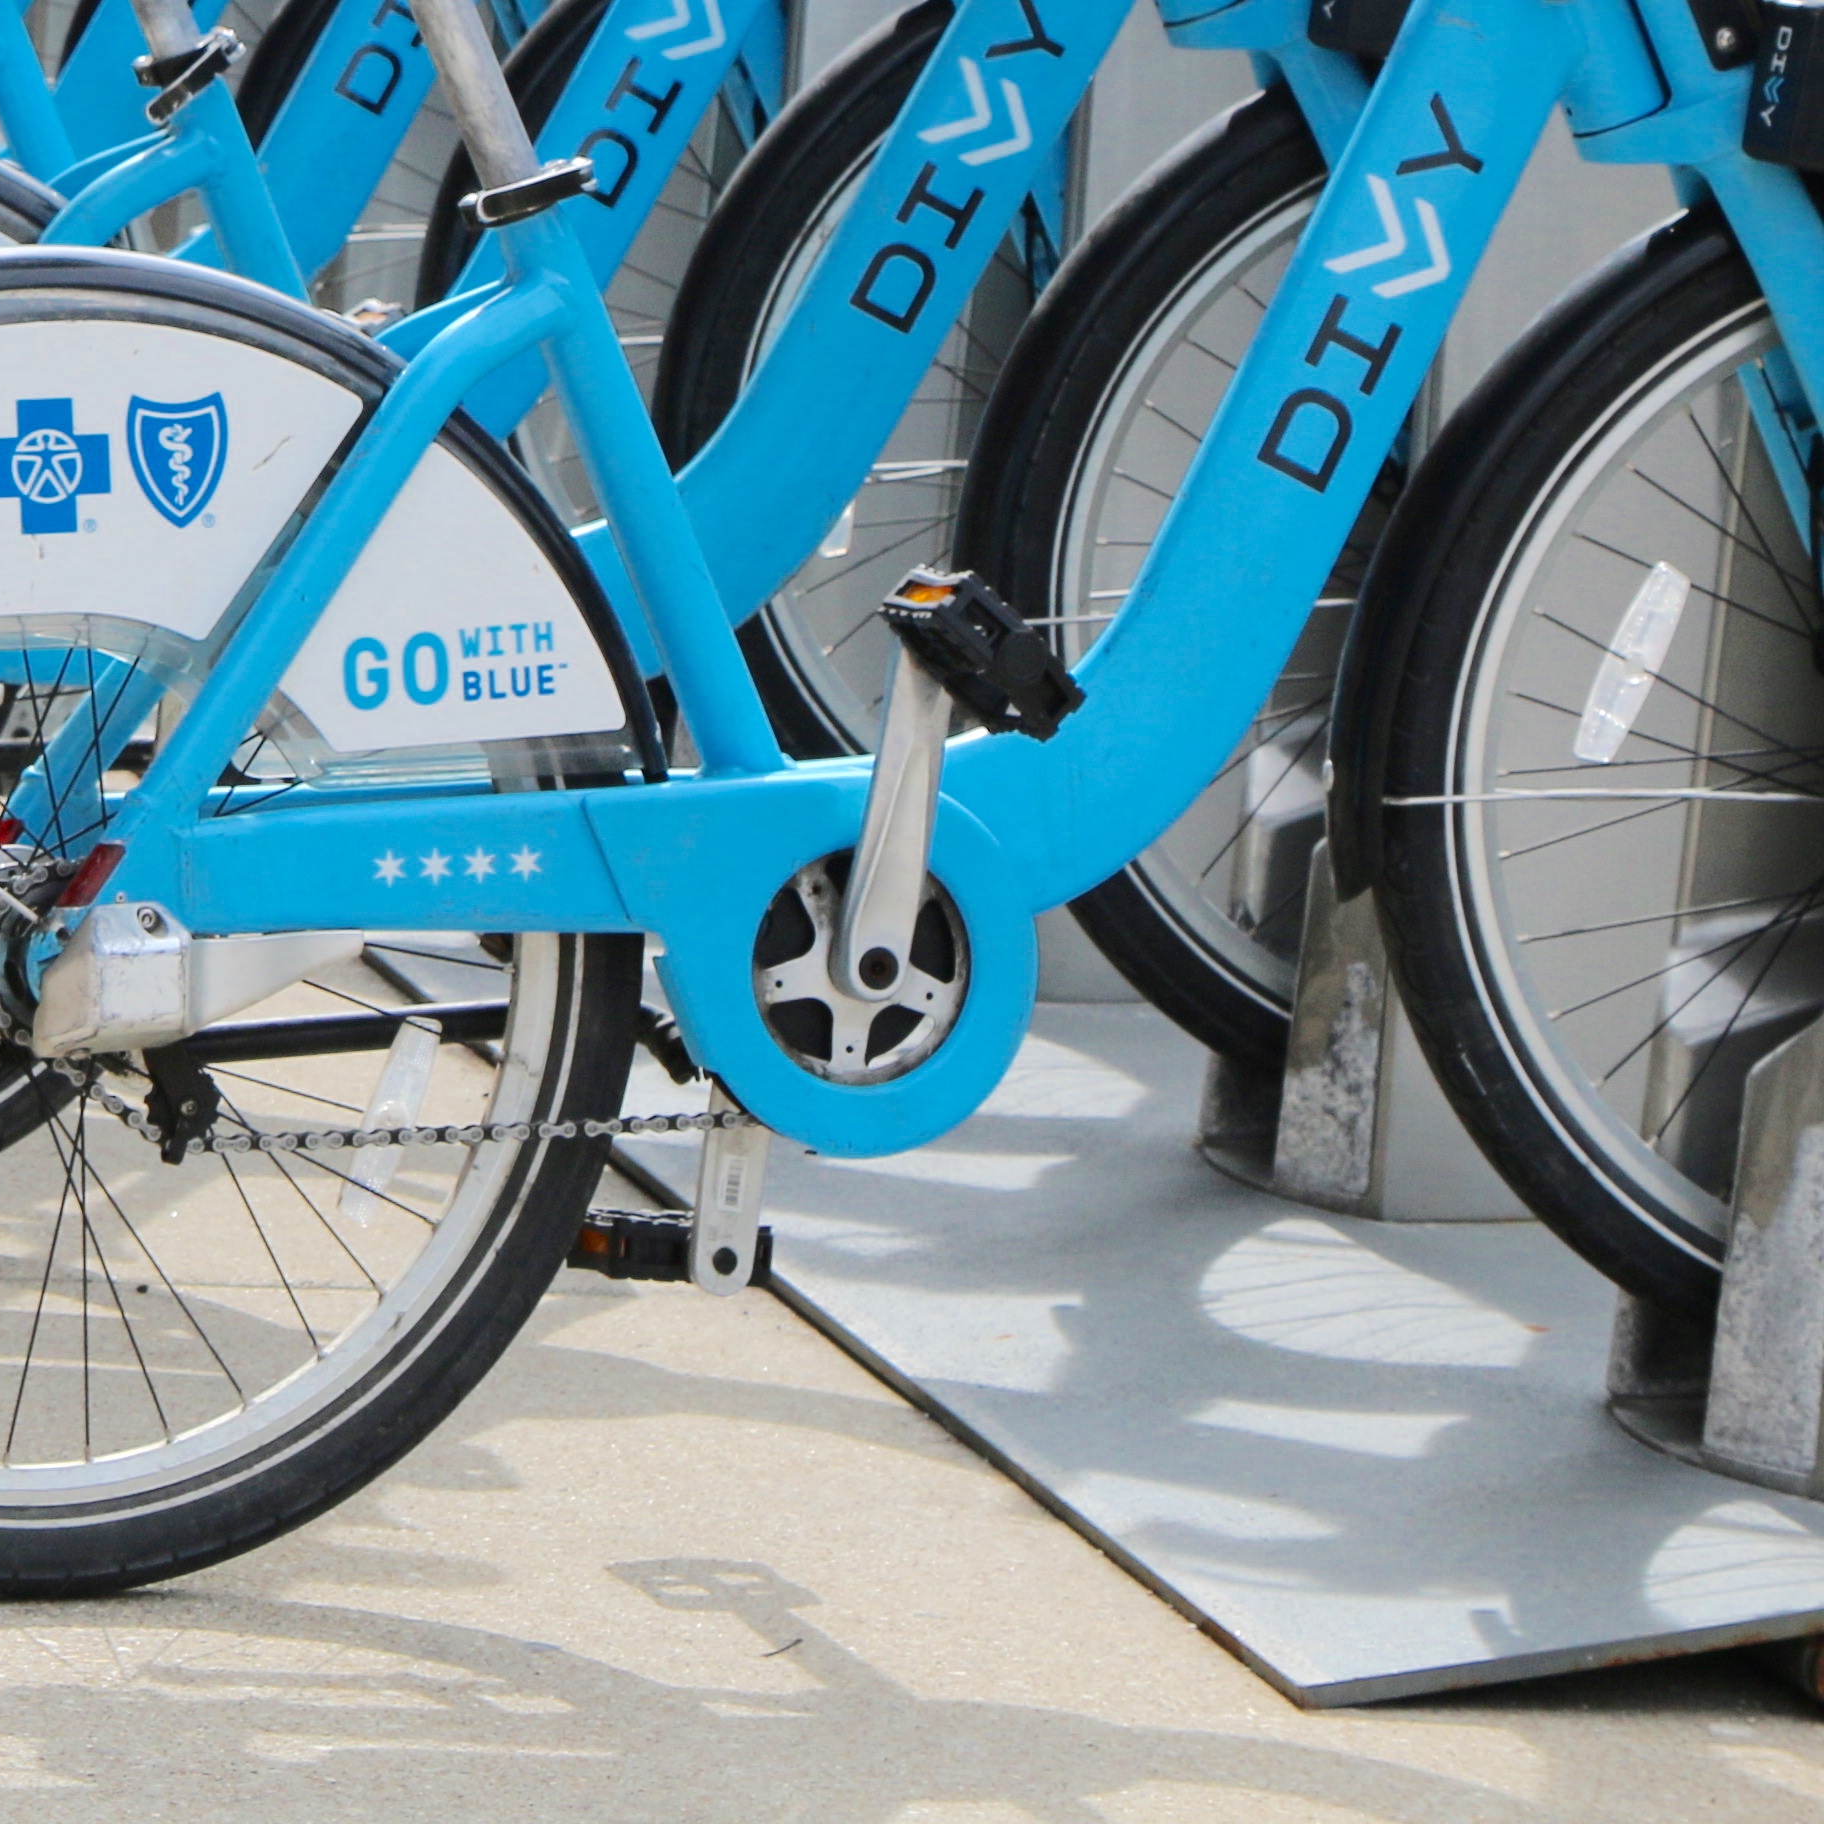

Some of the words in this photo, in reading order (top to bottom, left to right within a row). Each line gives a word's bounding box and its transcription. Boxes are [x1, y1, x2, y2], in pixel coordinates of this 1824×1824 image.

[458, 621, 555, 659] WITH
[343, 631, 449, 711] GO
[462, 663, 556, 702] BLUE
